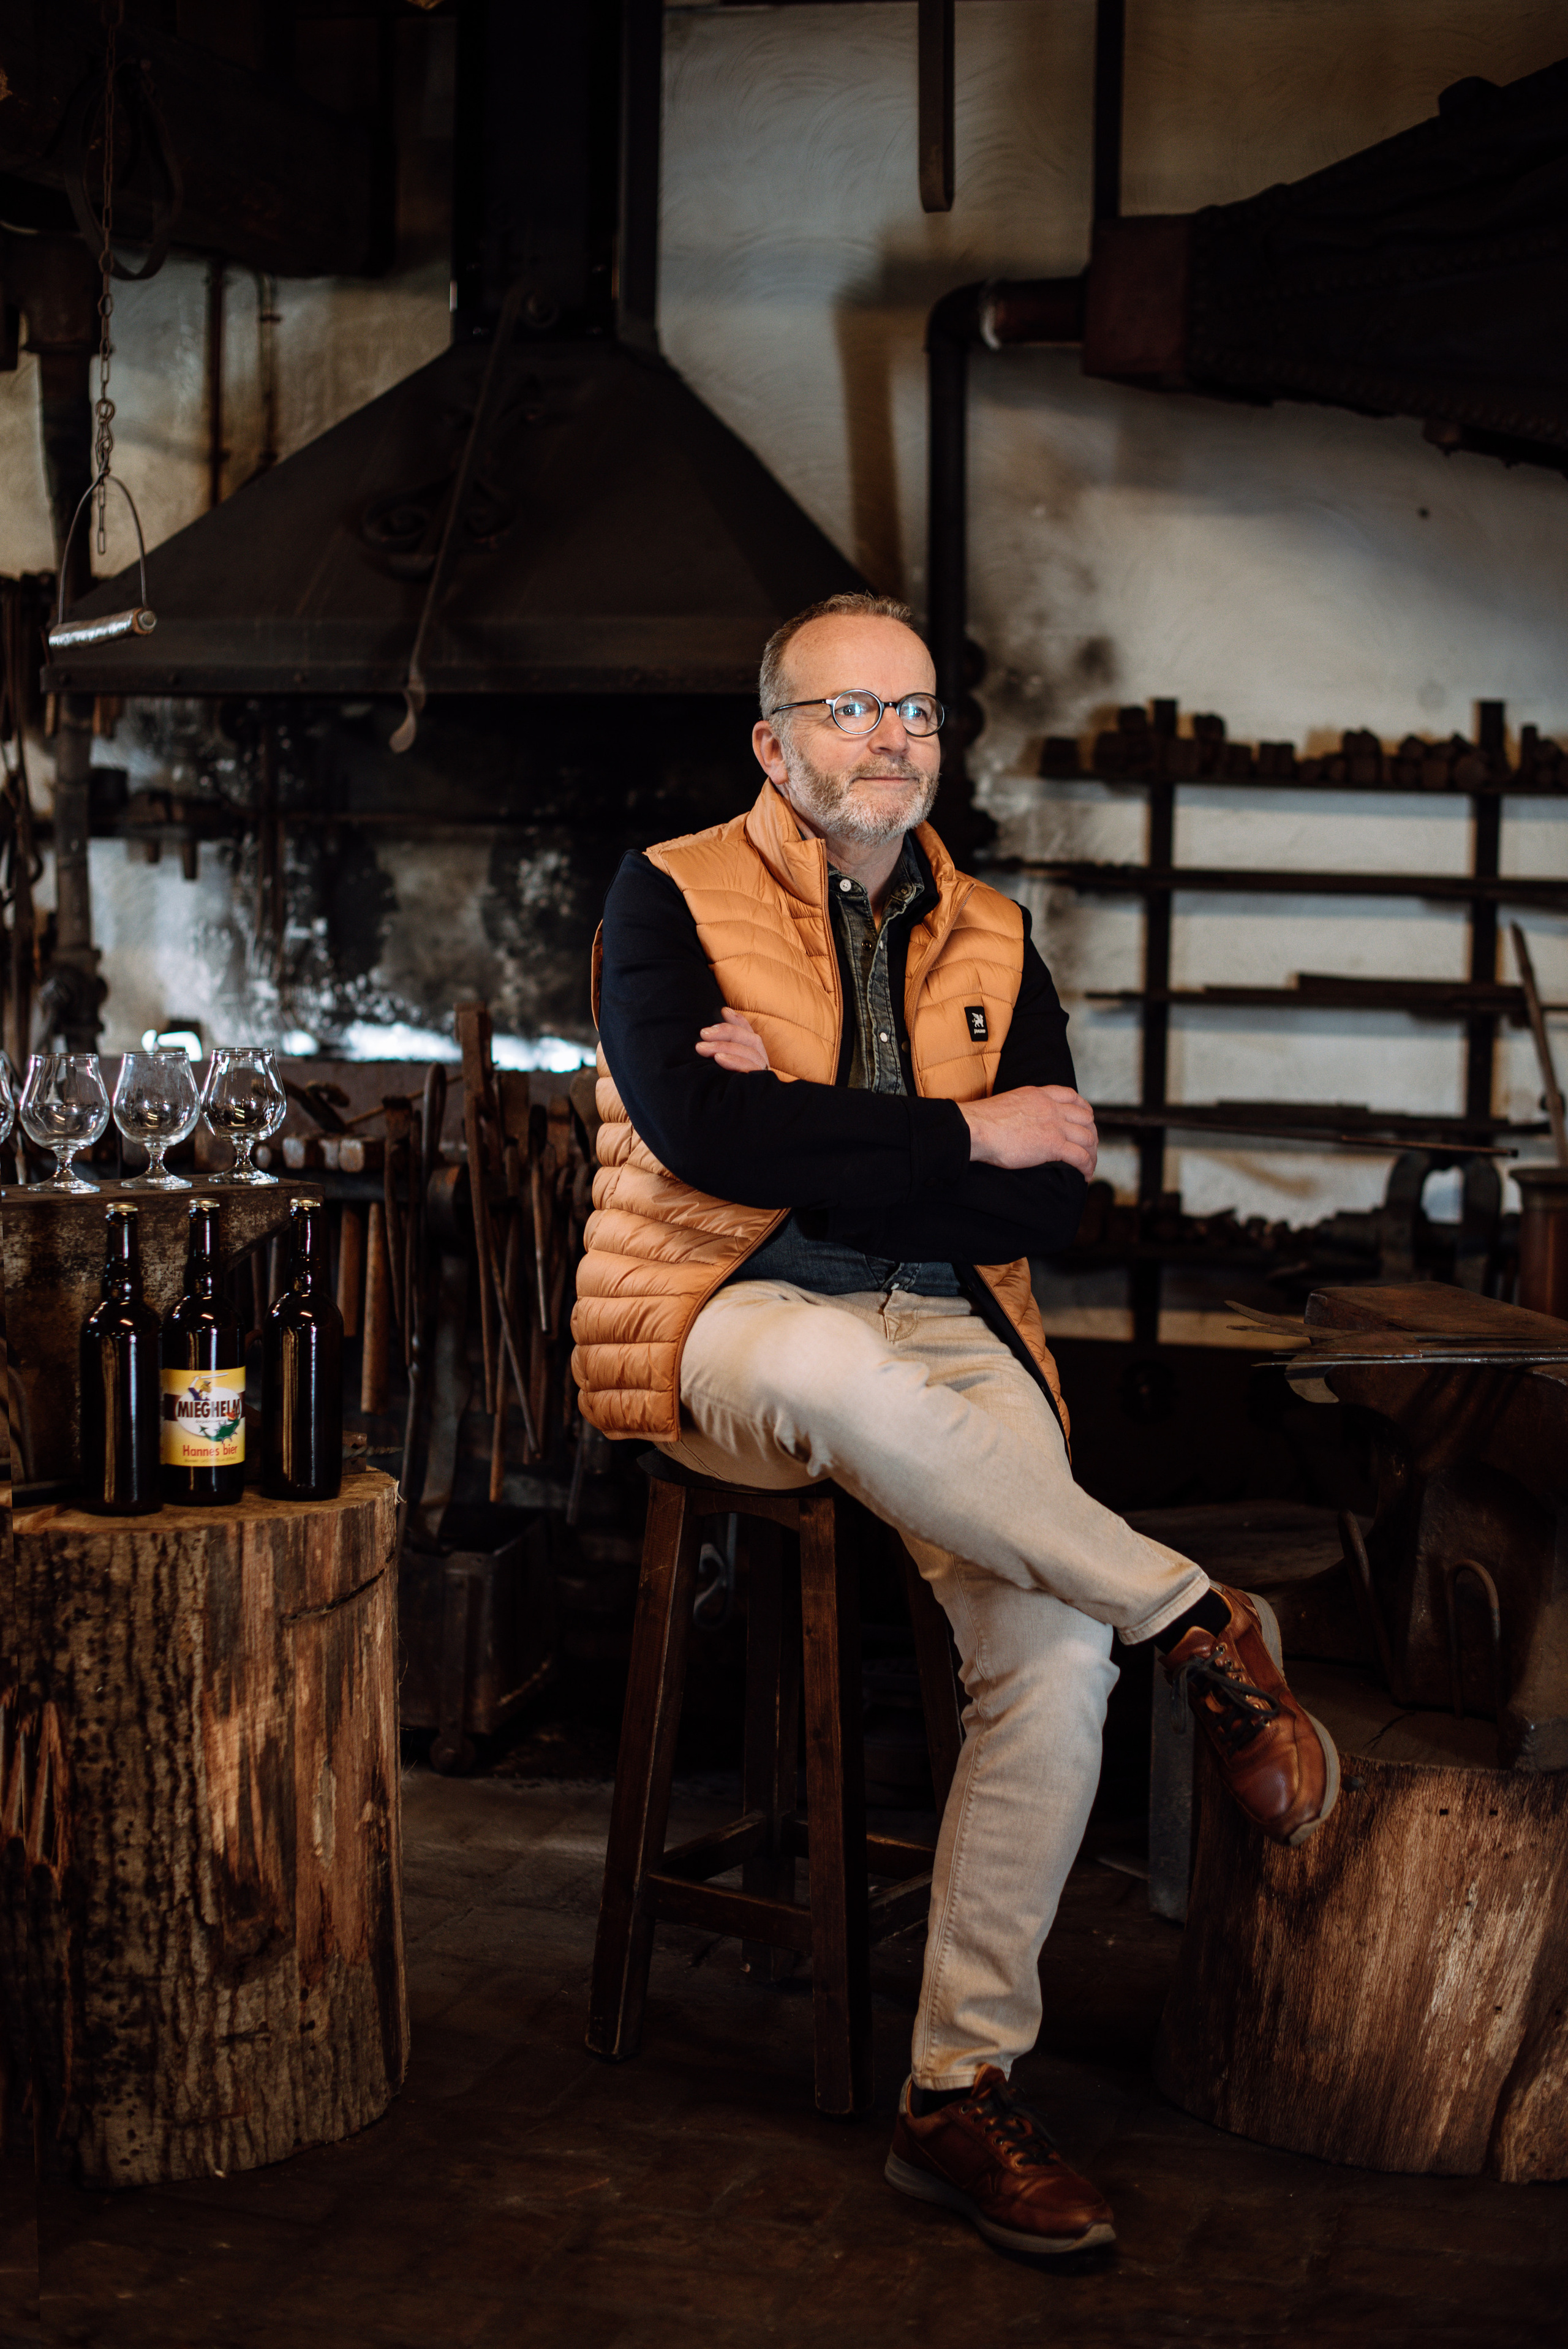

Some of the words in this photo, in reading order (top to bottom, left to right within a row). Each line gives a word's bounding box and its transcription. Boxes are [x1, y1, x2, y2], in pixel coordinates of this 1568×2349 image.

[178, 1399, 240, 1417] MIEGHELM
[183, 1445, 219, 1456] Hannes
[223, 1443, 238, 1455] bier
